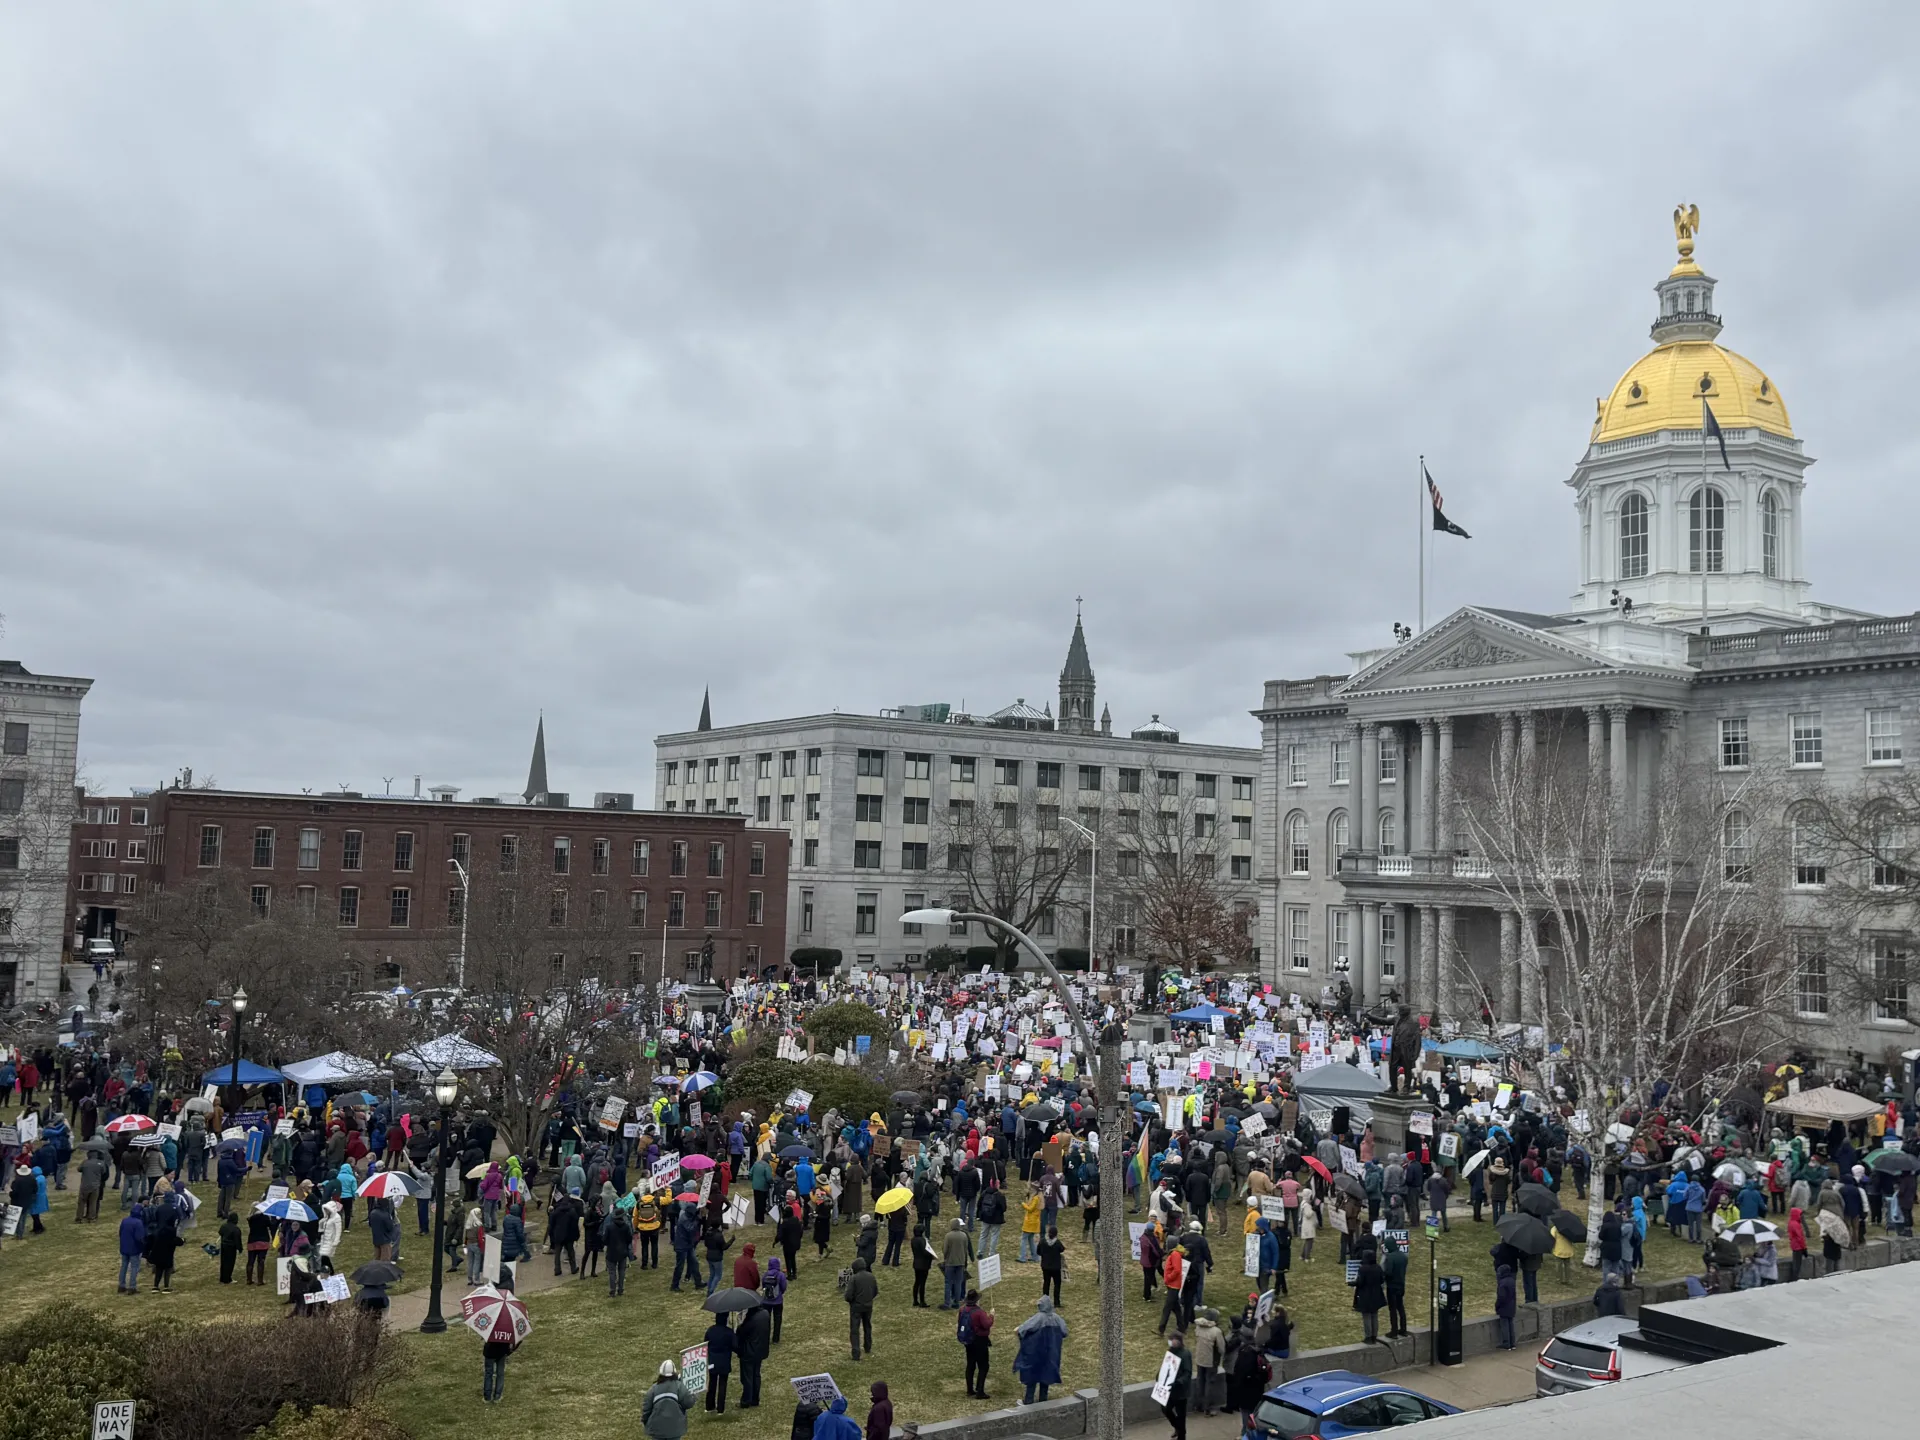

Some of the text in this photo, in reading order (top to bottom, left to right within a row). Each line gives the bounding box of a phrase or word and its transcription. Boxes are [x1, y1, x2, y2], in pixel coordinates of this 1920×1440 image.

[654, 1160, 670, 1174] DUMP
[1384, 1231, 1407, 1240] HATE
[465, 1300, 473, 1315] VFW
[494, 1330, 512, 1341] VFW
[101, 1405, 130, 1419] ONE
[99, 1419, 130, 1433] WAY
